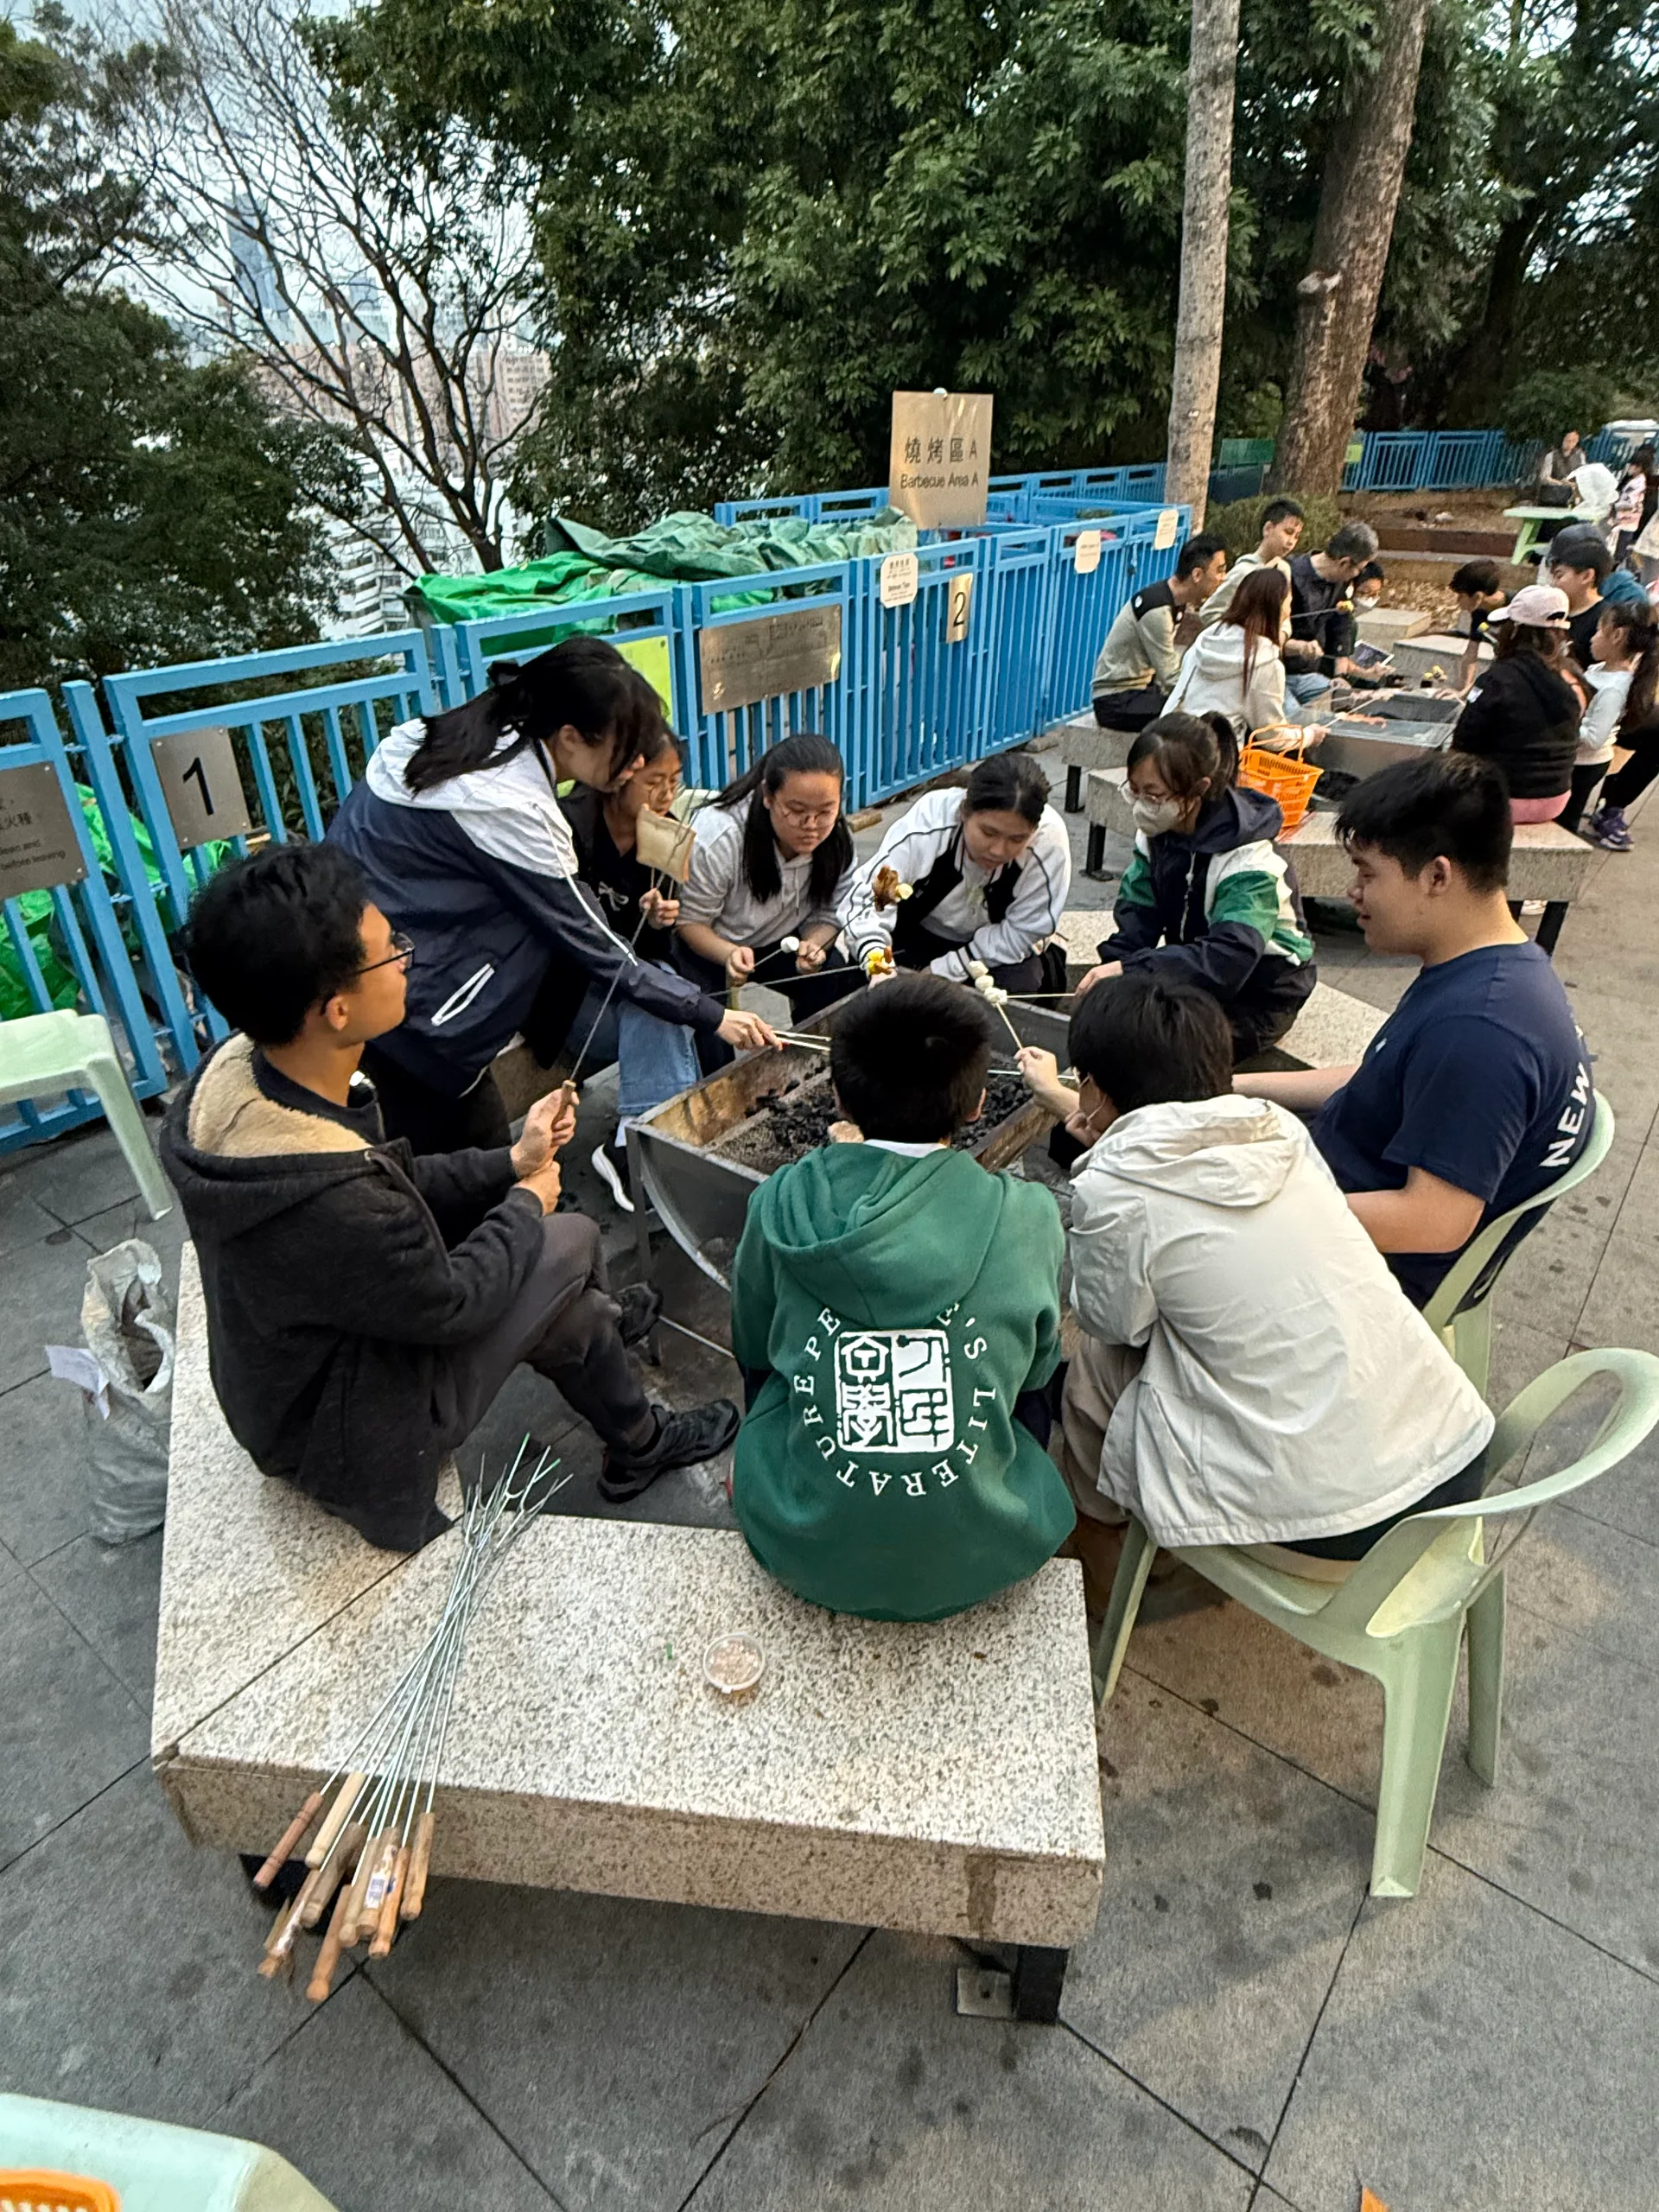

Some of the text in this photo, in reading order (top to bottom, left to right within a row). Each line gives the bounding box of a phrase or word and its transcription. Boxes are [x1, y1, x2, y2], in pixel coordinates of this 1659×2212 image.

[904, 435, 978, 464] 燒烤區 A
[900, 471, 979, 489] Barbecue Area A
[953, 592, 966, 628] 2
[182, 757, 214, 816] 1
[1539, 1062, 1590, 1167] NEW
[793, 1374, 997, 1497] LITERATURE
